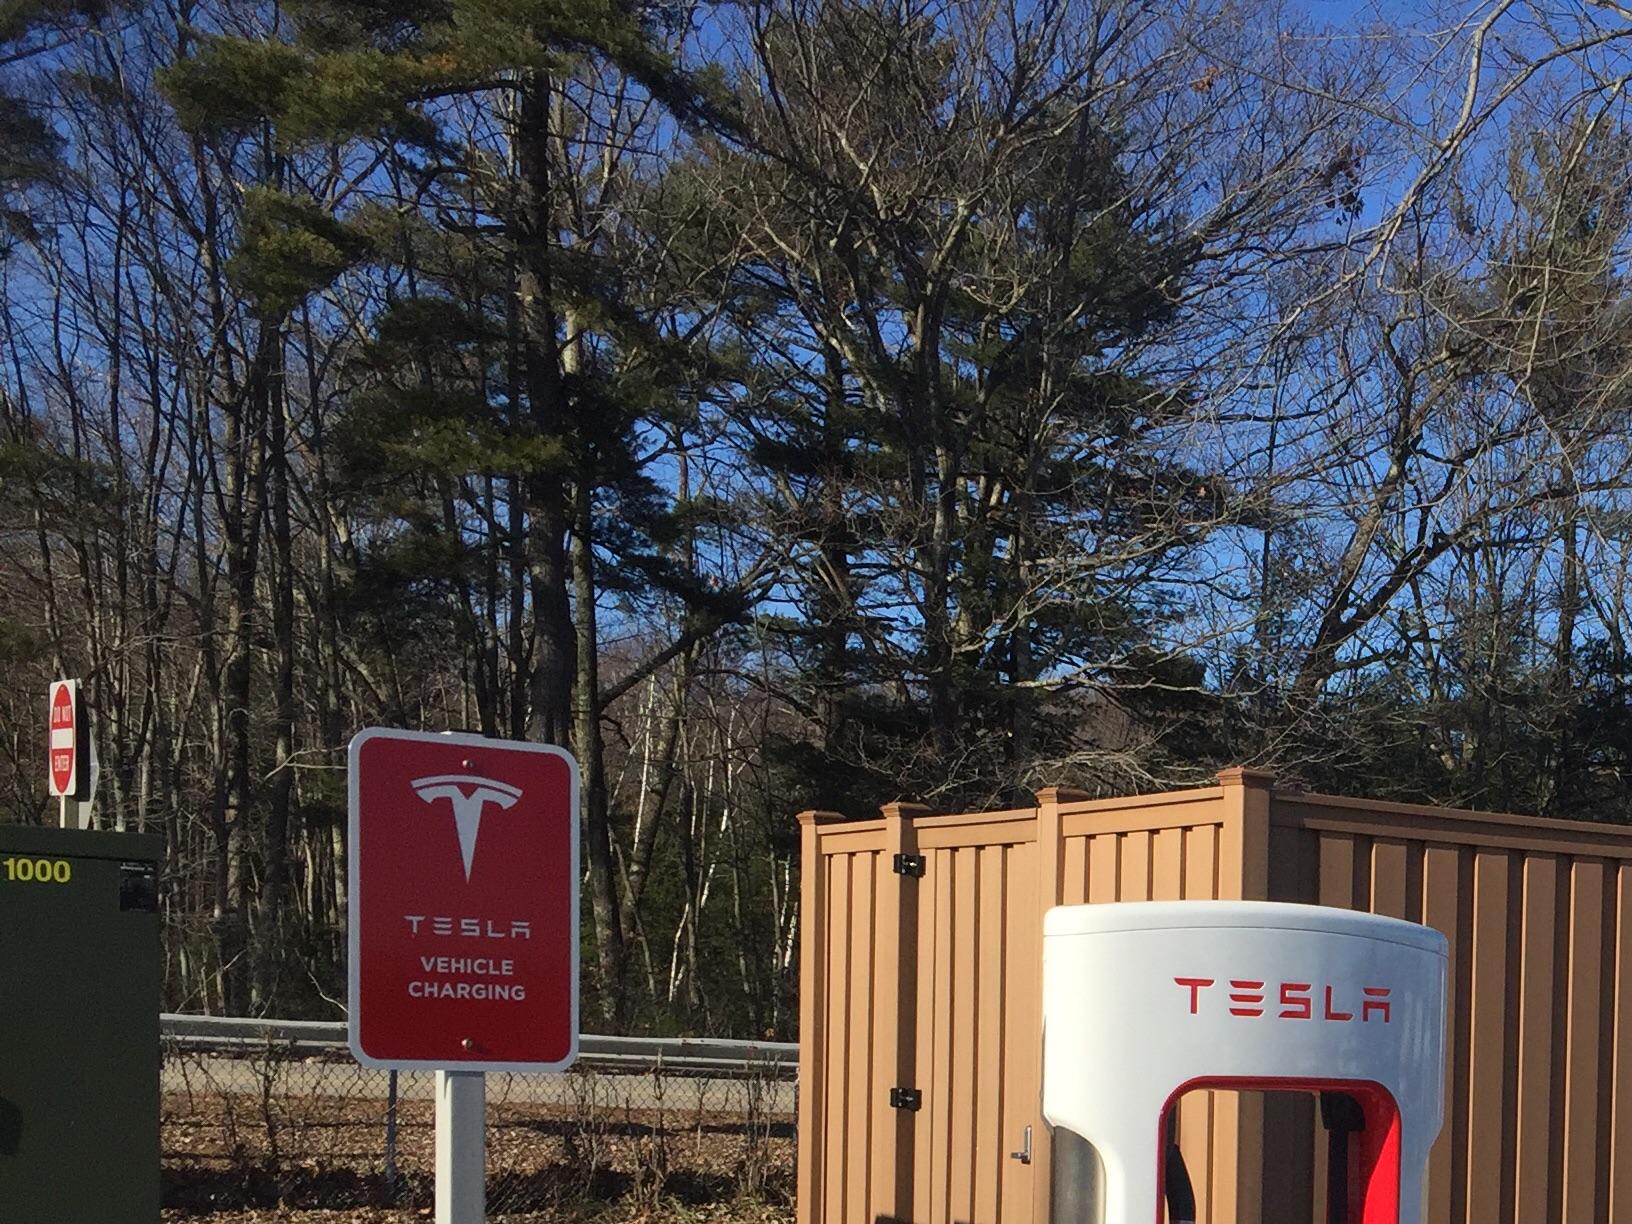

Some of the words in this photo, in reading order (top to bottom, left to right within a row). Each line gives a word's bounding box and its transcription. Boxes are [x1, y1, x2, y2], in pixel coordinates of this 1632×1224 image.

[2, 857, 71, 883] 1000
[404, 915, 530, 939] TESLA
[420, 956, 514, 975] VEHICLE
[408, 981, 526, 1001] CHARGING
[1173, 977, 1392, 1023] TESLA
